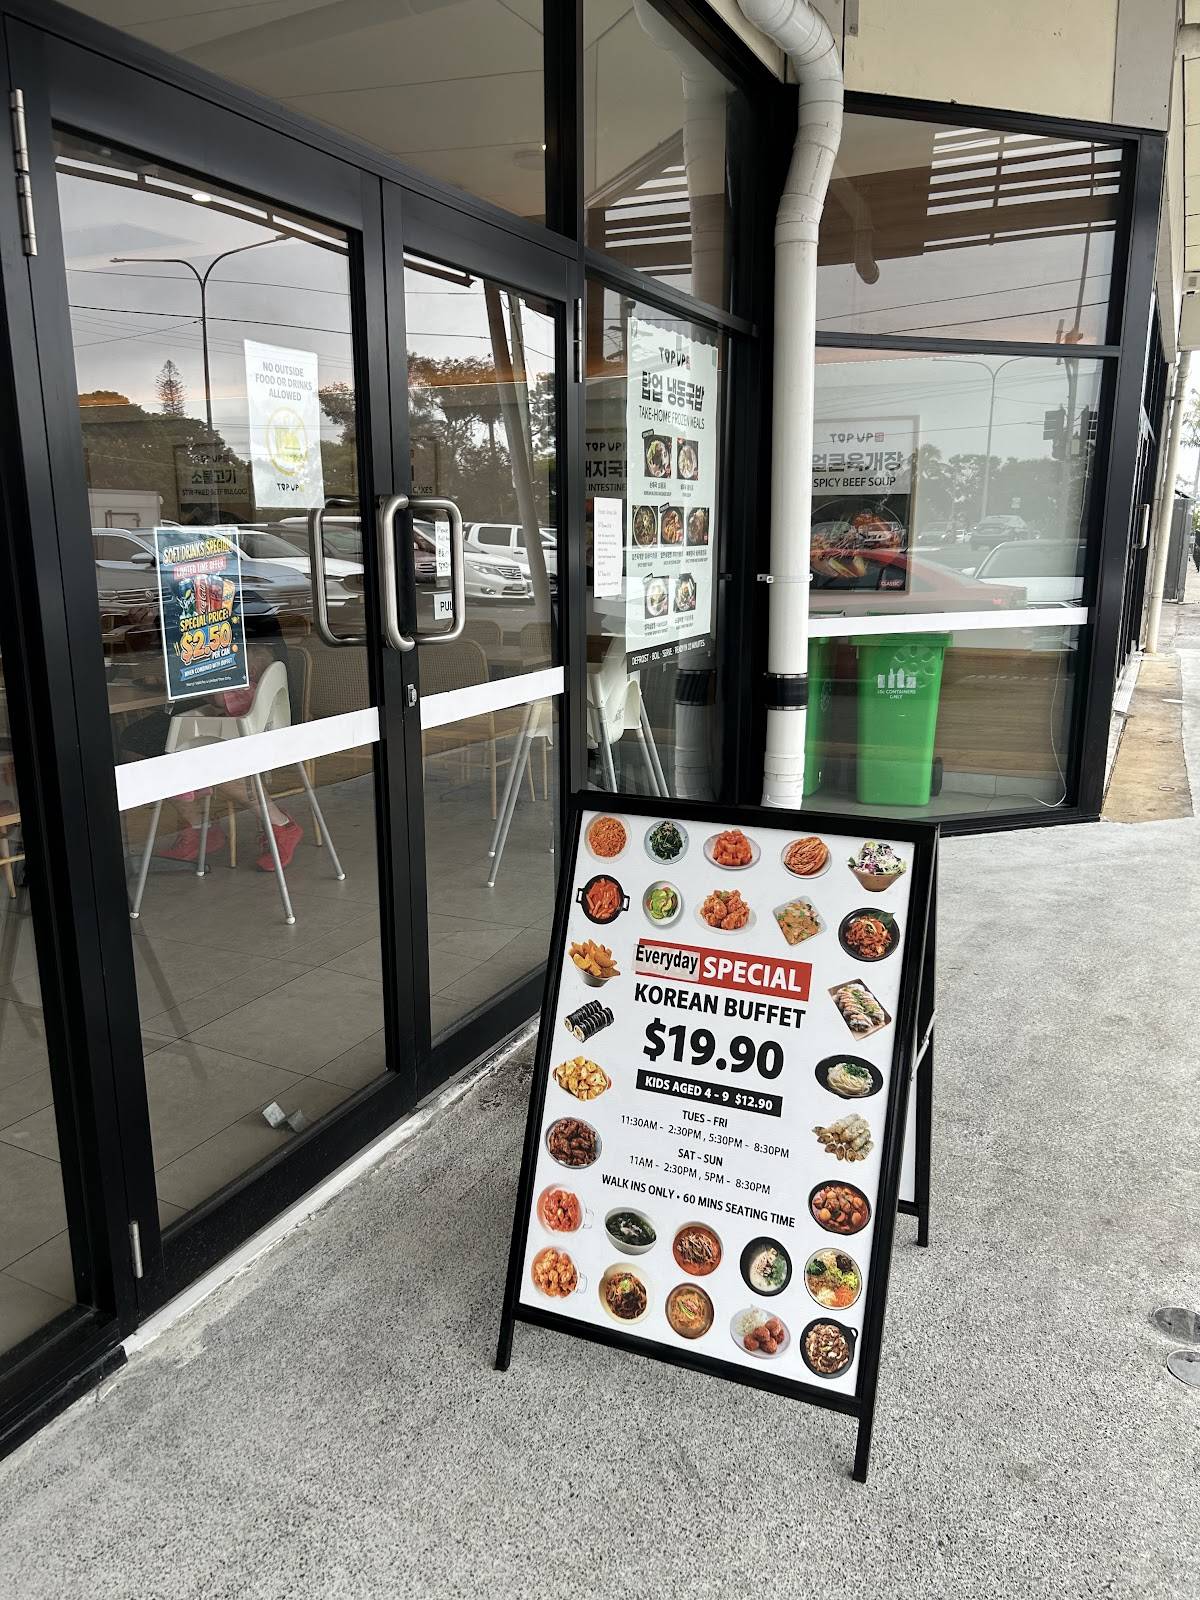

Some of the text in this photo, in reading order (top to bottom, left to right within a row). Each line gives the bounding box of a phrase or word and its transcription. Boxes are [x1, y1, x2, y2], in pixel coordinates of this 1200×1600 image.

[659, 347, 686, 367] TOP UP
[262, 360, 304, 377] NO OUTSIDE
[256, 373, 312, 391] FOOD OR DRINKS
[269, 388, 302, 401] ALLOWED
[667, 376, 704, 412] 냉동국밥
[639, 405, 671, 423] TAKE-HOME
[672, 412, 690, 427] FROZEN
[586, 442, 622, 452] TOP UP
[830, 432, 874, 443] TOP UP
[277, 482, 300, 492] TOP UP
[813, 476, 896, 488] SPICY BEEF SOUP
[164, 546, 180, 565] SOFT
[181, 541, 205, 560] DRINKS
[176, 564, 196, 578] LIMITED
[210, 558, 224, 571] OFFER
[180, 613, 206, 632] SPECIAL
[180, 621, 232, 666] $2.50
[632, 653, 650, 666] DEFROST
[652, 652, 660, 660] BOIL
[636, 944, 802, 992] Everyday SPECIAL
[634, 982, 806, 1029] KOREAN BUFFET
[642, 1018, 784, 1080] $19.90
[644, 1076, 670, 1091] KIDS
[672, 1082, 702, 1097] AGED
[704, 1088, 712, 1098] 4
[722, 1091, 730, 1102] 9
[734, 1092, 773, 1111] $12.90
[682, 1110, 705, 1123] TUES
[713, 1116, 728, 1128] FRI
[620, 1114, 658, 1130] 11:30AM
[668, 1124, 701, 1140] 2:30PM
[708, 1133, 742, 1148] 5:30PM
[754, 1142, 790, 1158] 8:30PM
[678, 1148, 696, 1160] SAT
[704, 1153, 723, 1167] SUN
[629, 1155, 653, 1169] 11AM
[664, 1162, 698, 1179] 2:30PM
[704, 1171, 724, 1184] 5PM
[735, 1178, 771, 1195] 8:30PM
[602, 1174, 796, 1228] WALK INS ONLY 60 MINS SEATING TIME
